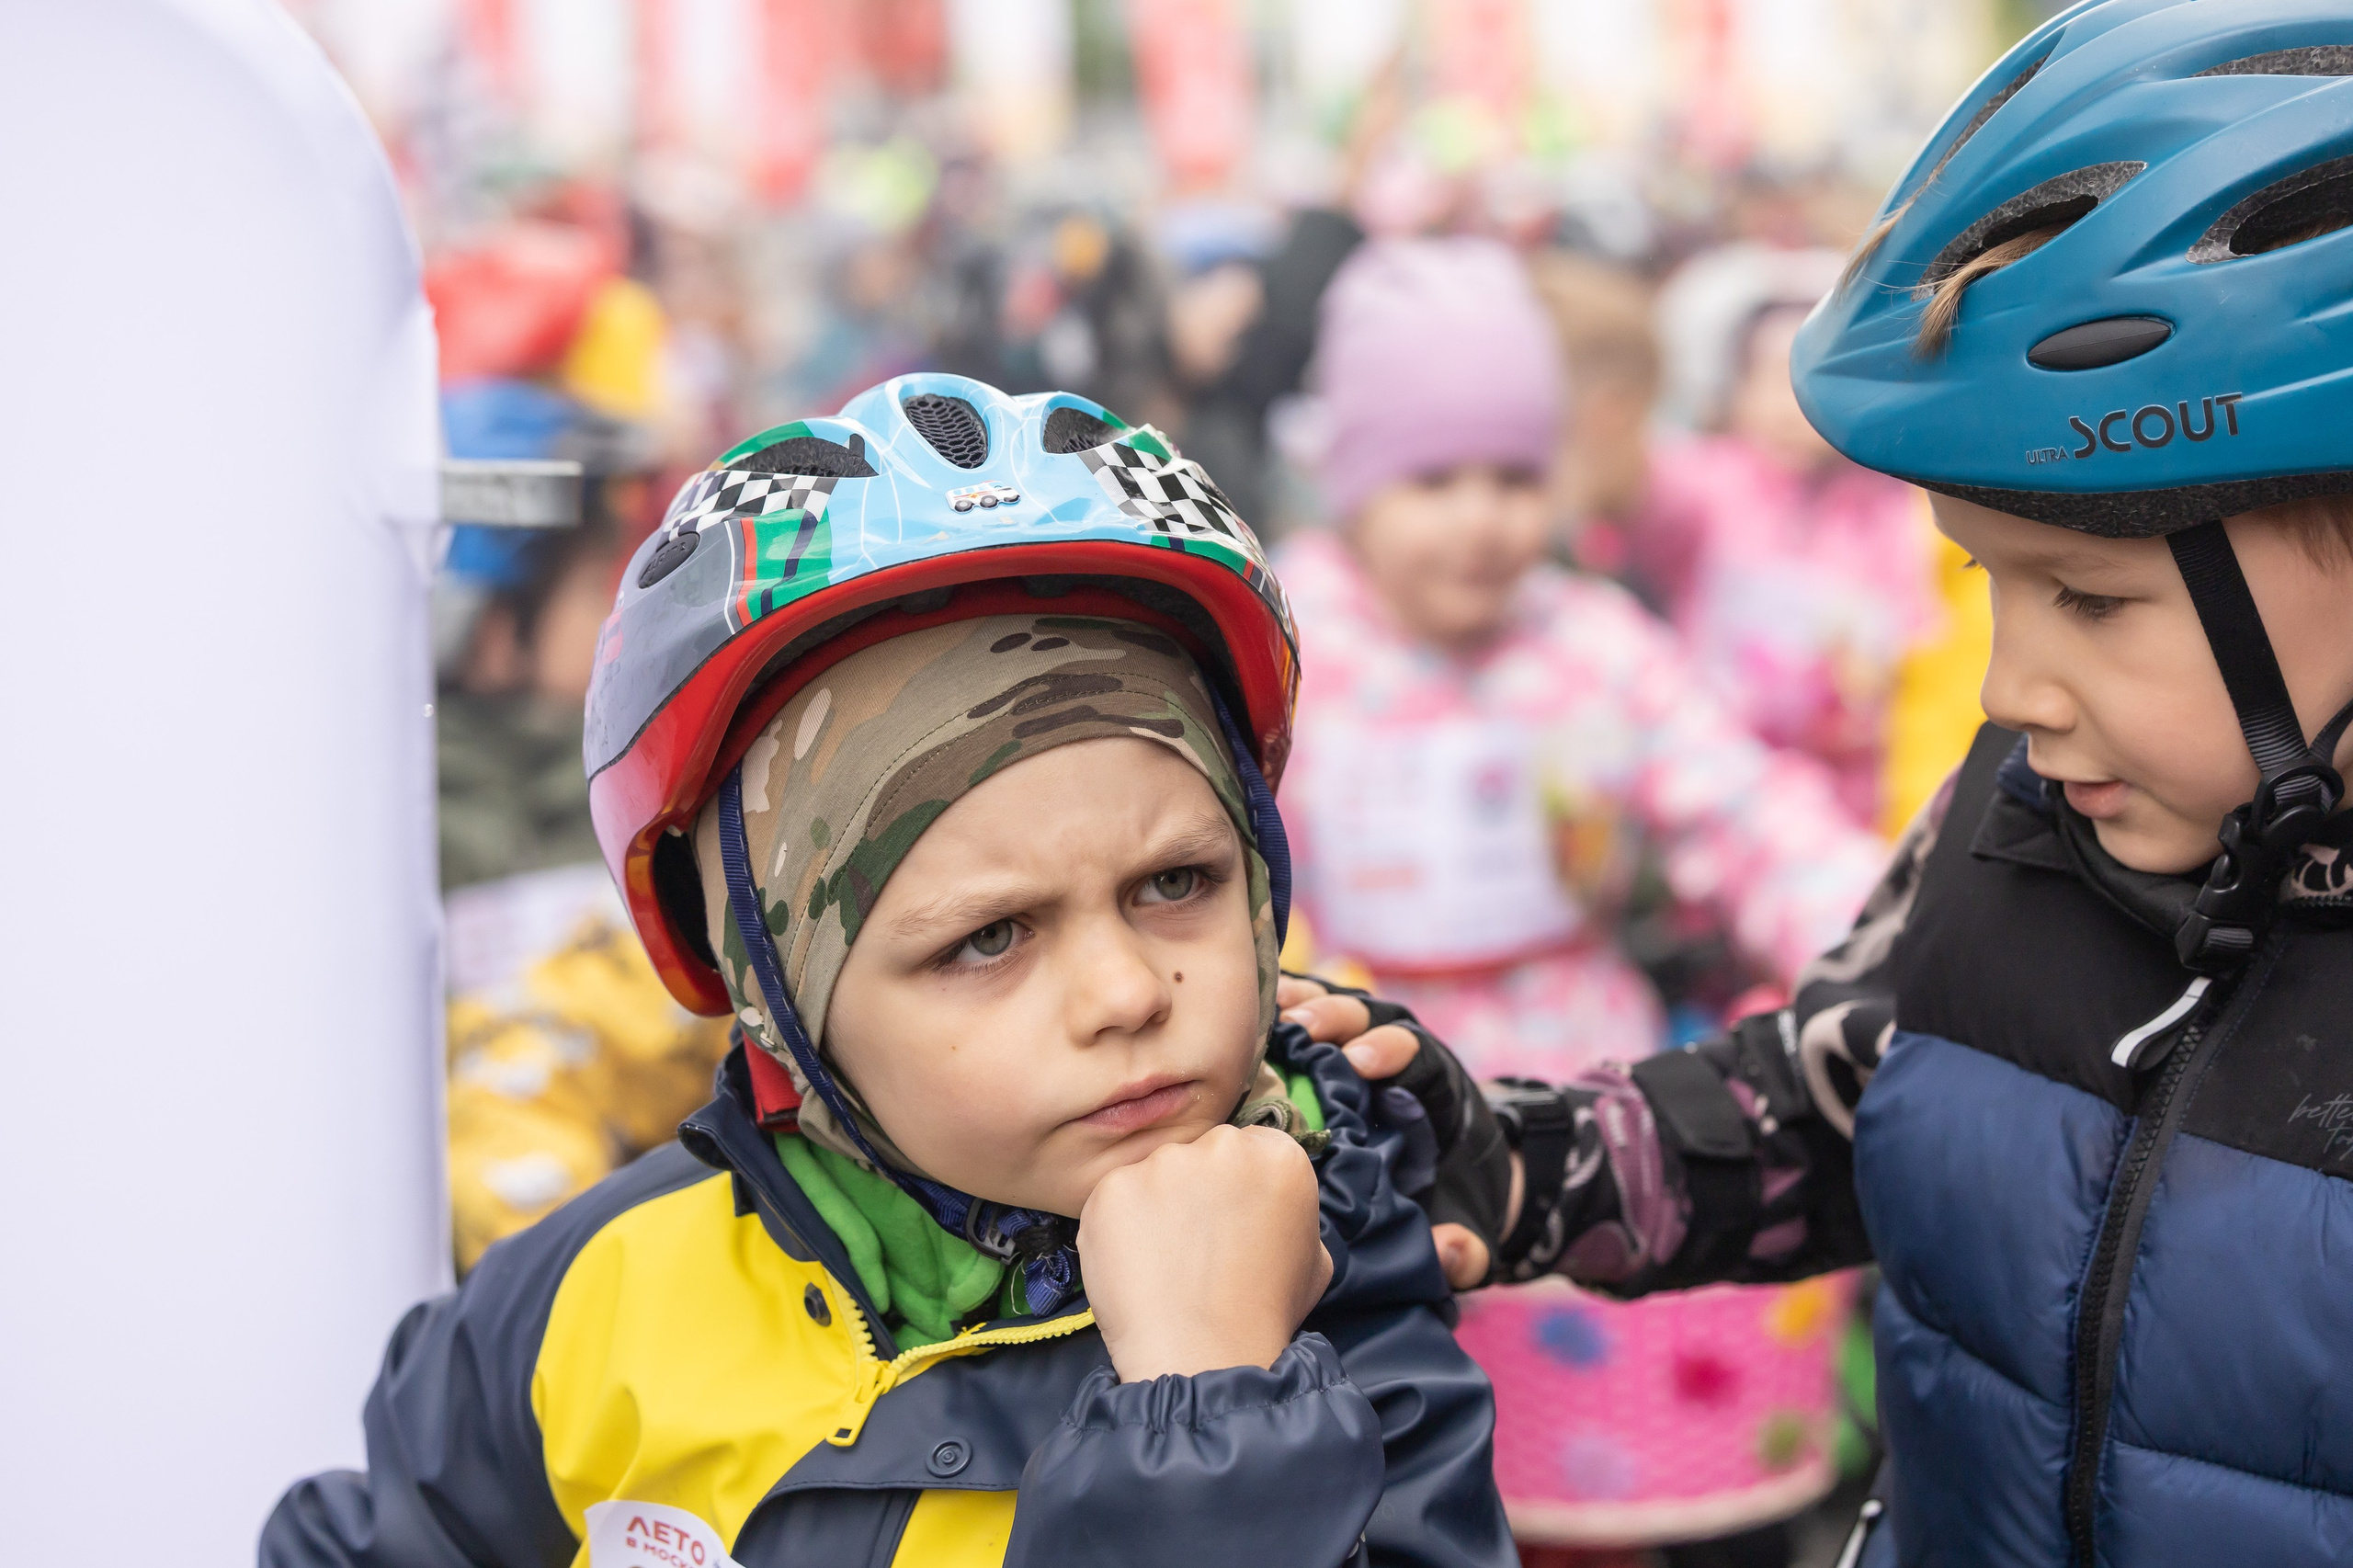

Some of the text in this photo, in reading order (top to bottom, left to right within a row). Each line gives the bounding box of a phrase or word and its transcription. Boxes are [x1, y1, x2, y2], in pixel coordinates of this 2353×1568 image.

[2026, 392, 2243, 465] ULTRA SCOUT
[2288, 1093, 2353, 1128] bette
[627, 1517, 705, 1566] ЛЕТО
